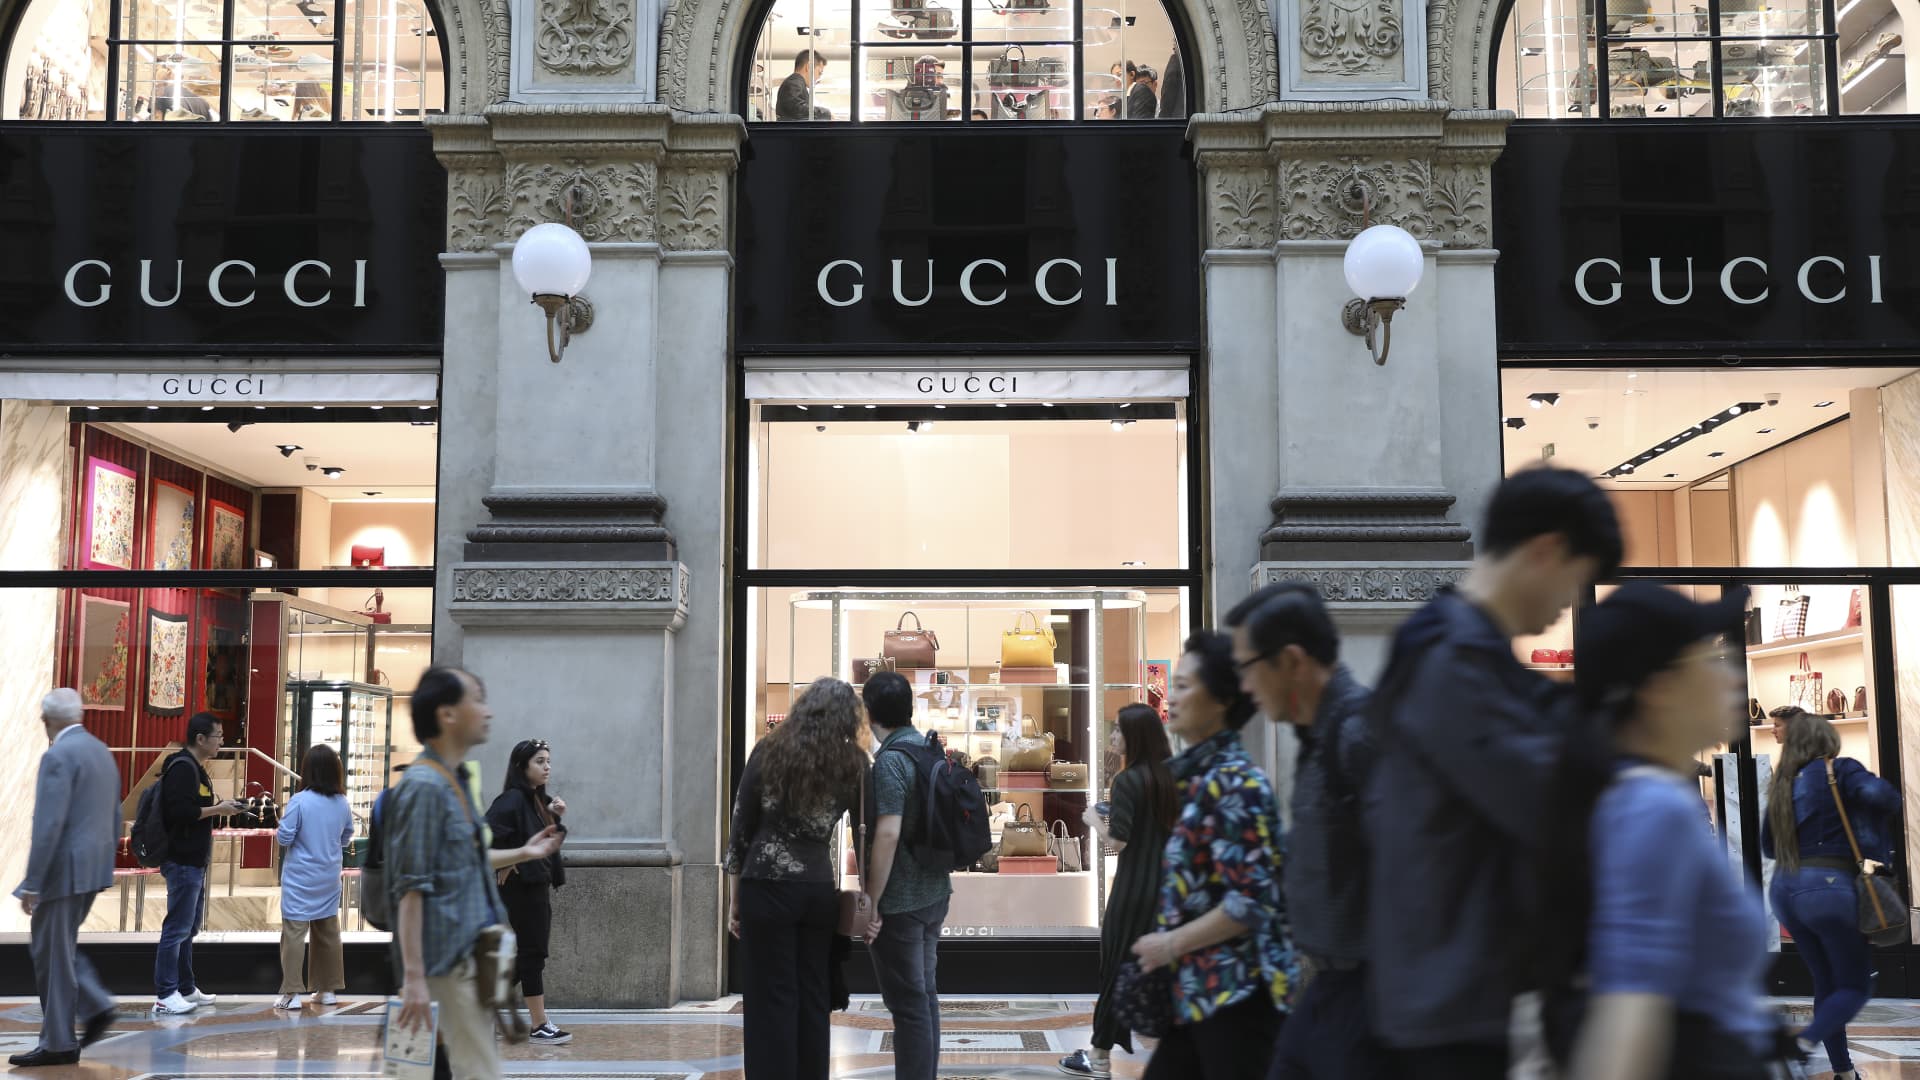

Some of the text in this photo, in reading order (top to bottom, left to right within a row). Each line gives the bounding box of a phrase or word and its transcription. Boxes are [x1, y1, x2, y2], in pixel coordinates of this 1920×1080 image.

[63, 258, 367, 307] GUCCI
[817, 258, 1118, 307] GUCCI
[1574, 255, 1883, 306] GUCCI
[163, 378, 264, 395] GUCCI
[917, 376, 1018, 393] GUCCI
